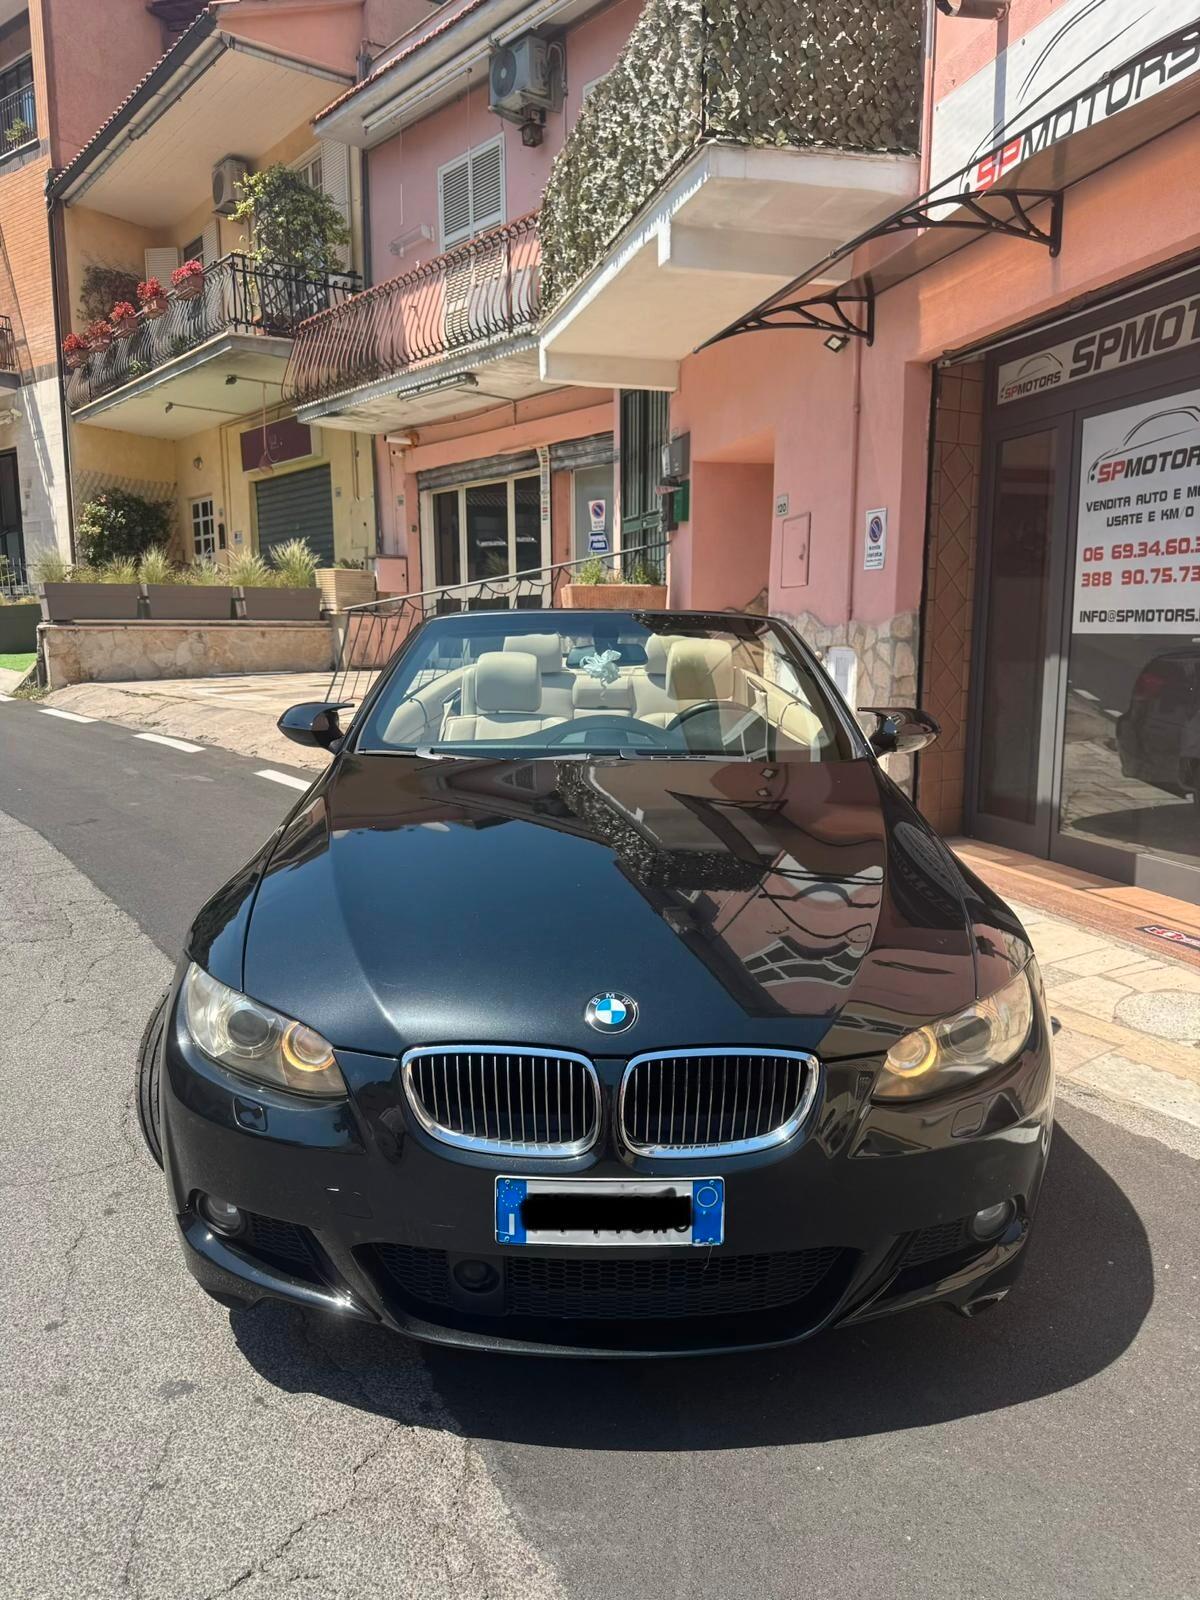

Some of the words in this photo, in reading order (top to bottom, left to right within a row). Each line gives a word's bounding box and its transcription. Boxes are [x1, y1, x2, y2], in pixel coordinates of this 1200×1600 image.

[1086, 496, 1131, 512] VENDITA
[1136, 490, 1168, 506] AUTO
[1174, 488, 1181, 500] E
[1187, 485, 1200, 499] M
[1106, 513, 1143, 527] USATE
[1148, 511, 1155, 522] E
[1083, 546, 1104, 562] 06
[1081, 571, 1112, 587] 388
[1079, 608, 1200, 623] INFO@SPMOTORS.
